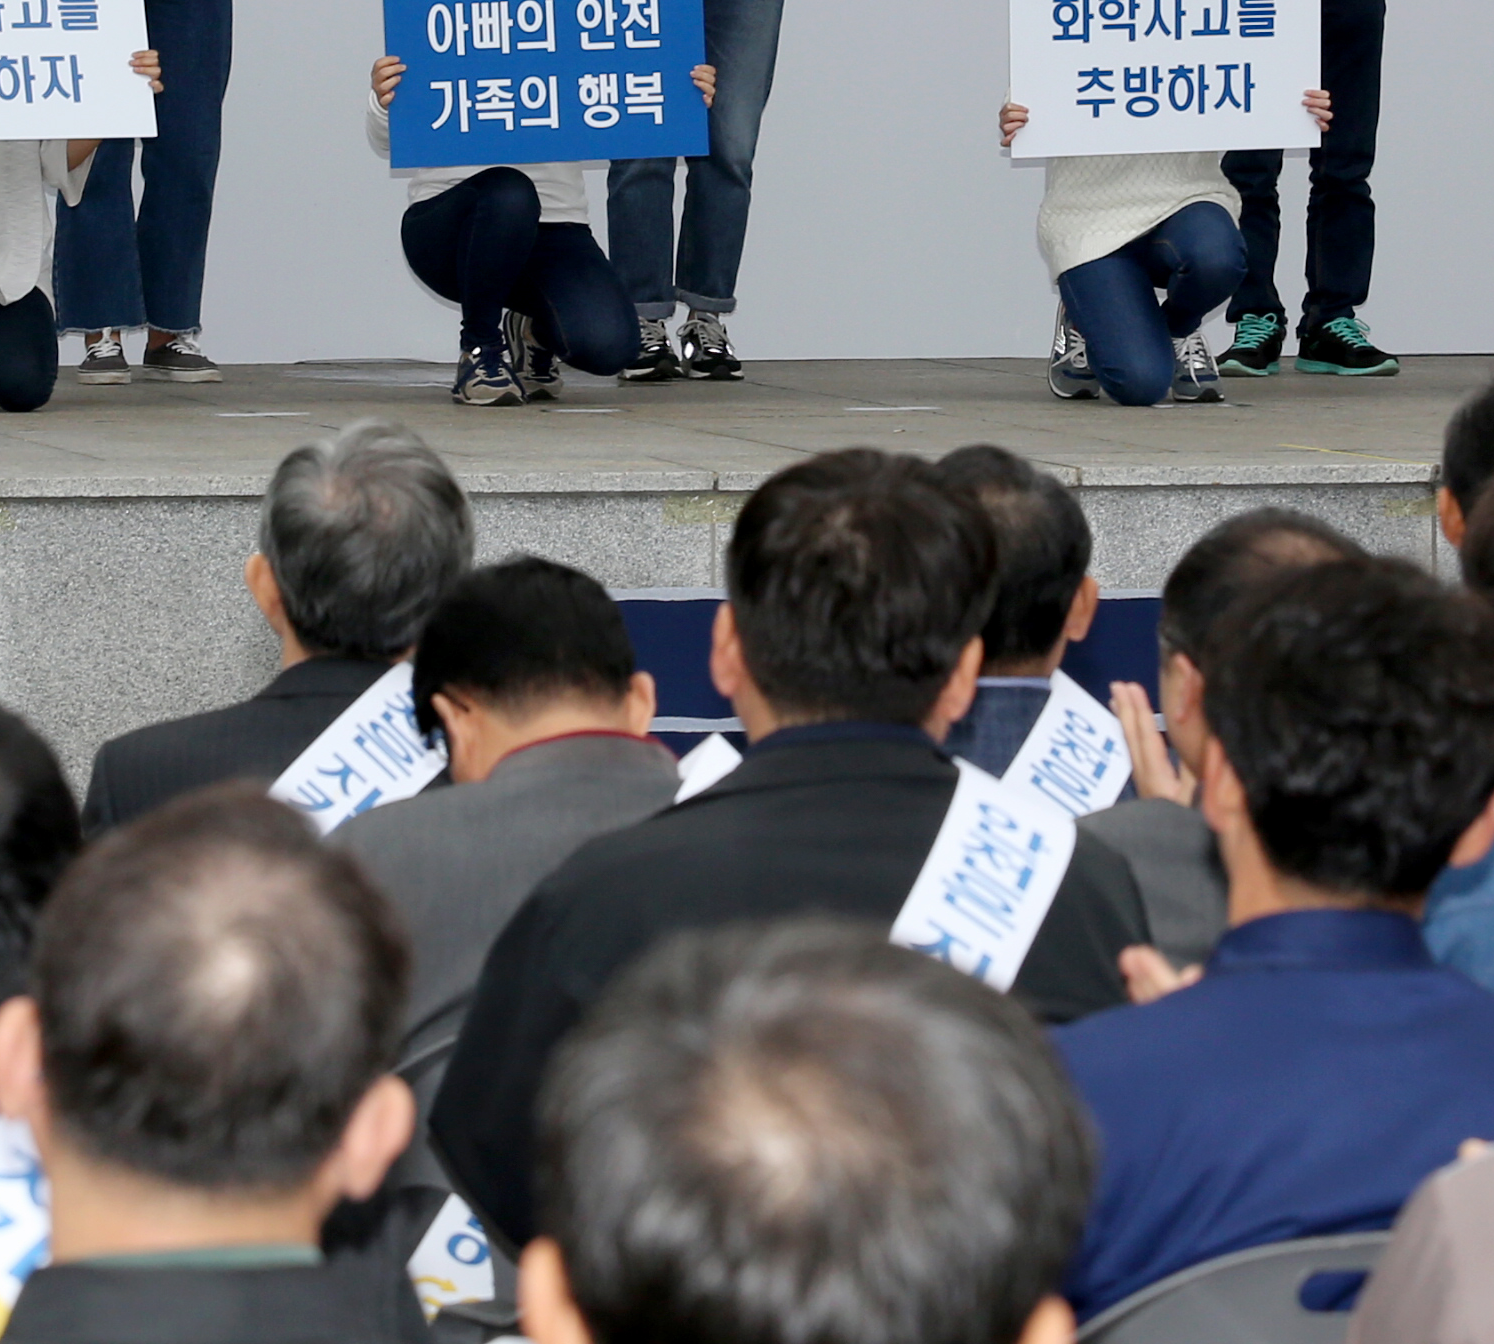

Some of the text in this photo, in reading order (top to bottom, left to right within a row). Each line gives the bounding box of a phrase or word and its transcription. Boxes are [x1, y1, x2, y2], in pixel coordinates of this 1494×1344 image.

[426, 0, 556, 55] 아빠의
[430, 72, 664, 132] 가족의 행복
[1076, 62, 1255, 118] 추방하자
